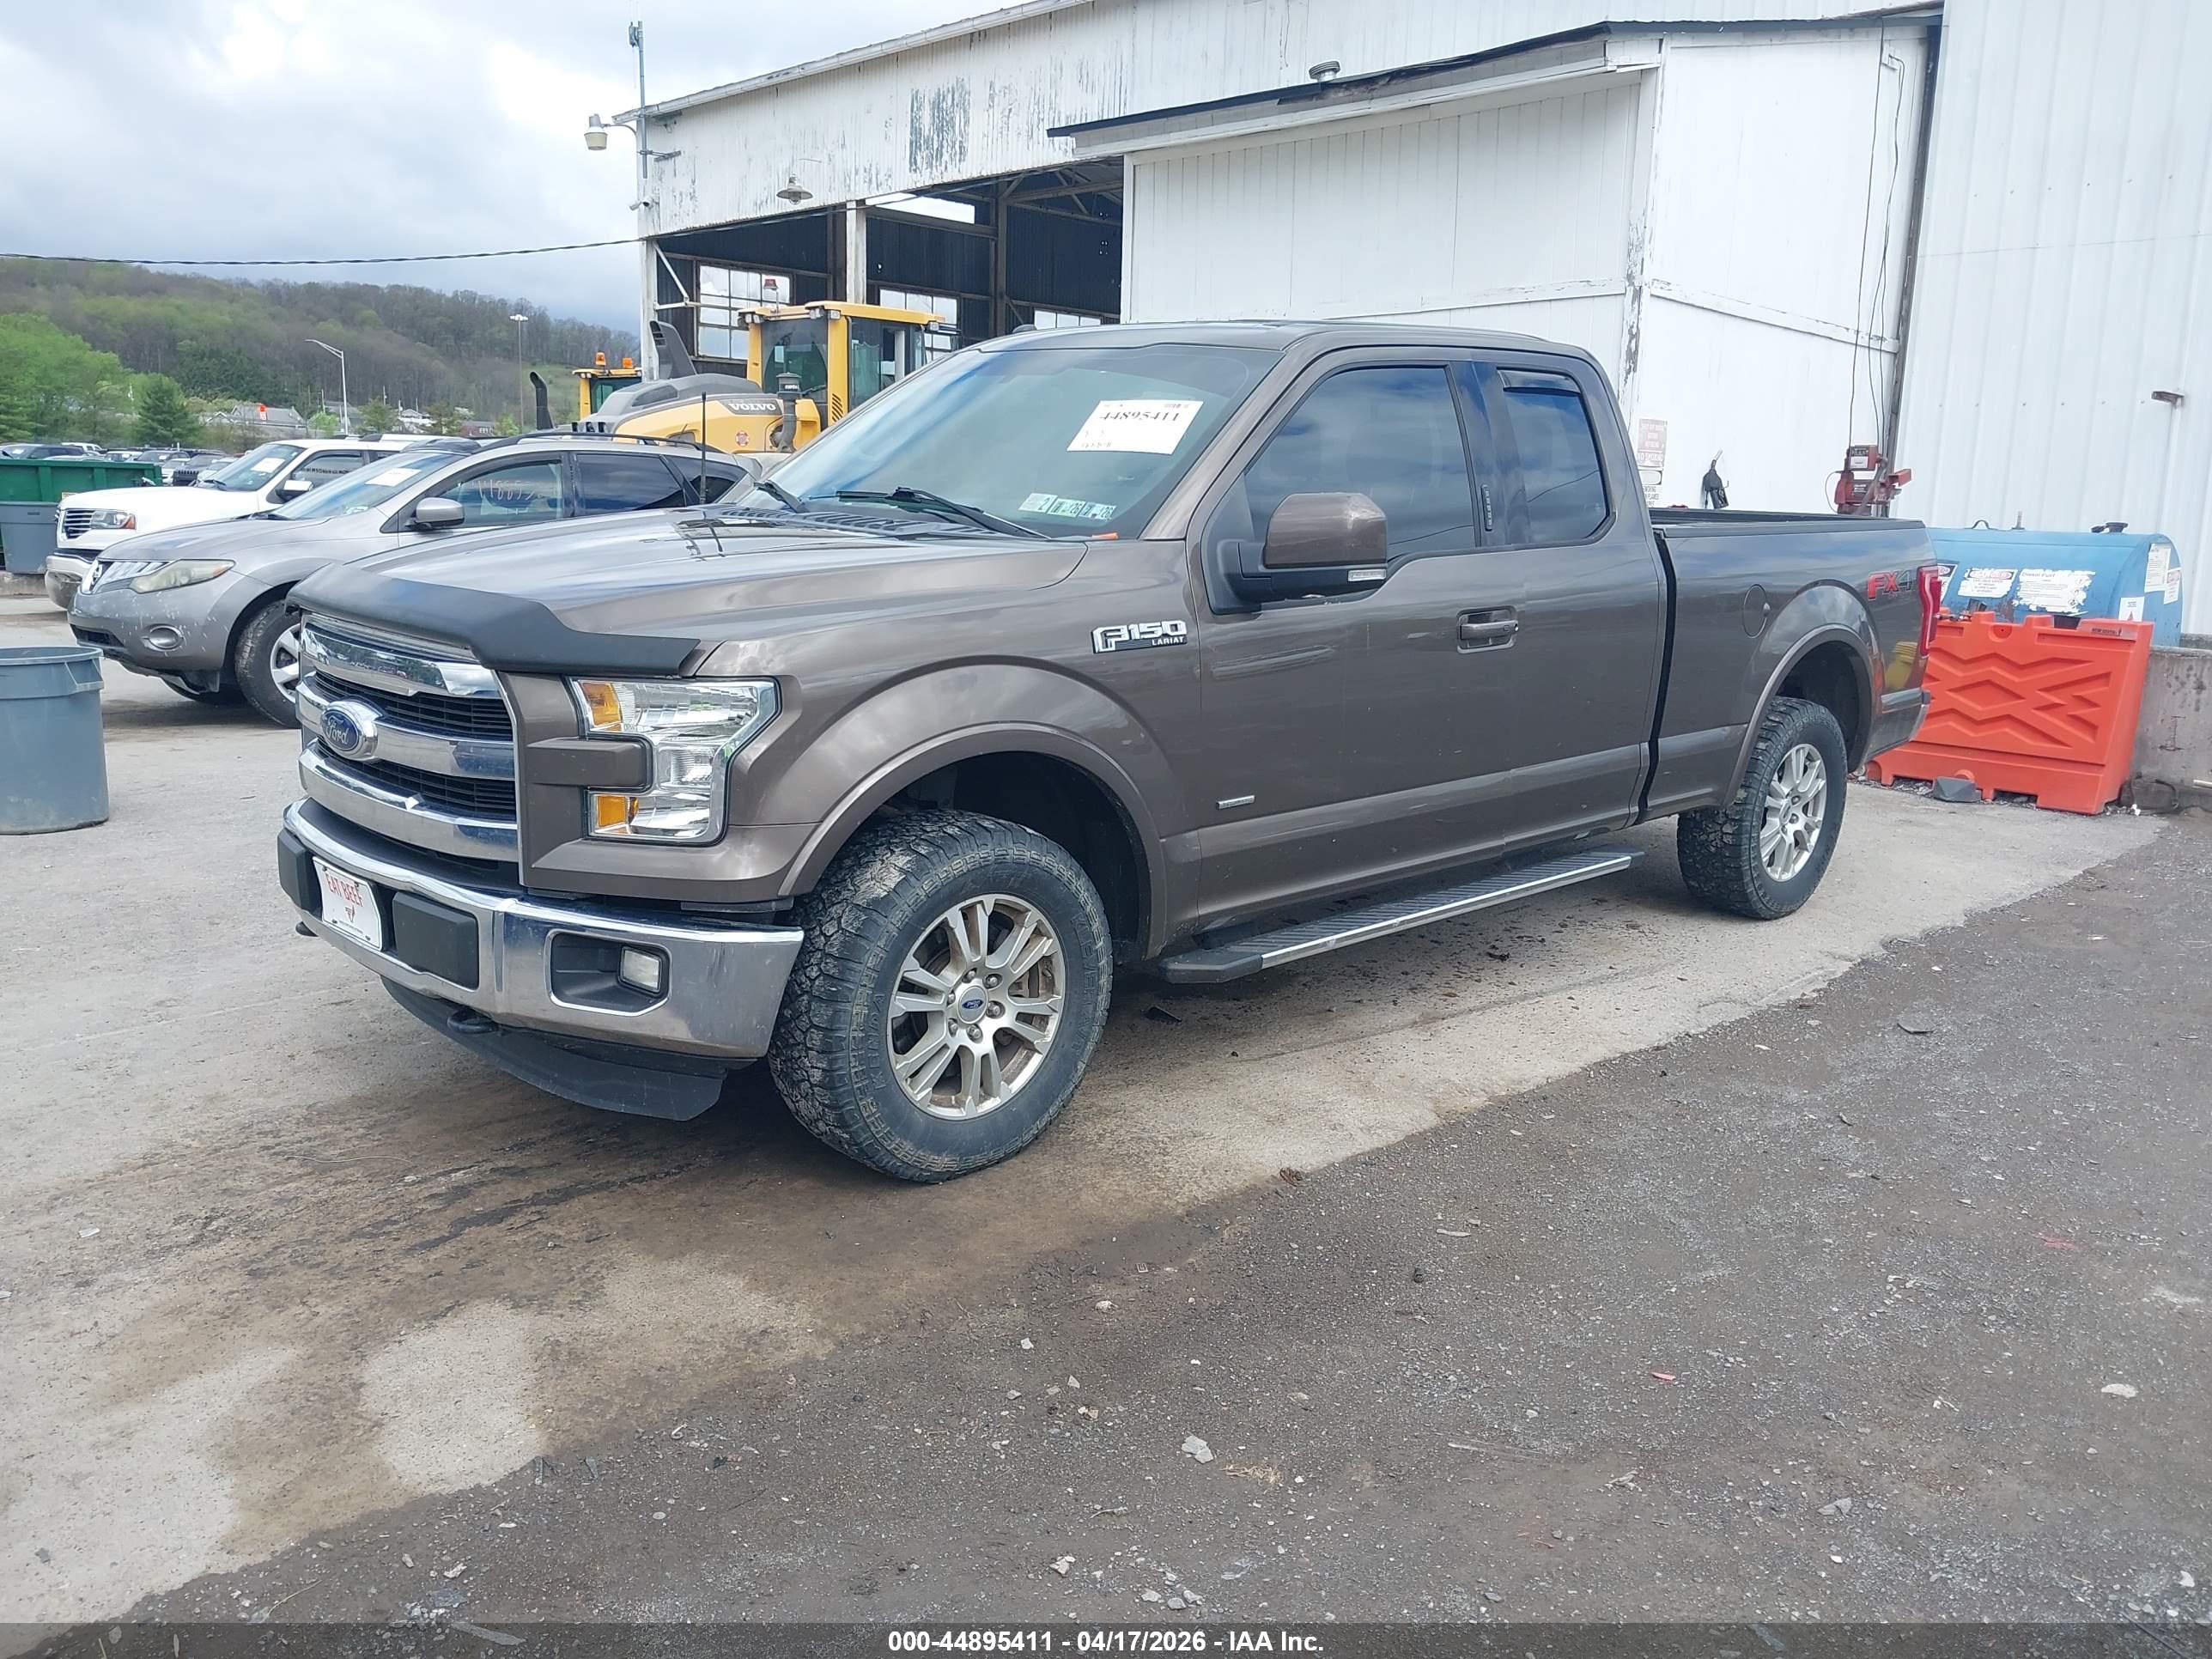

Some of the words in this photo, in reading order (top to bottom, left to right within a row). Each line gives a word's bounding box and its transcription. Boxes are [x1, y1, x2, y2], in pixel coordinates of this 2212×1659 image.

[1099, 411, 1180, 422] 44895411
[1868, 569, 1912, 599] FX4
[1152, 636, 1184, 646] LARIAT
[326, 715, 349, 745] Ford
[325, 872, 342, 897] EAT
[340, 880, 363, 907] BEEF
[867, 994, 887, 1090] KENDA
